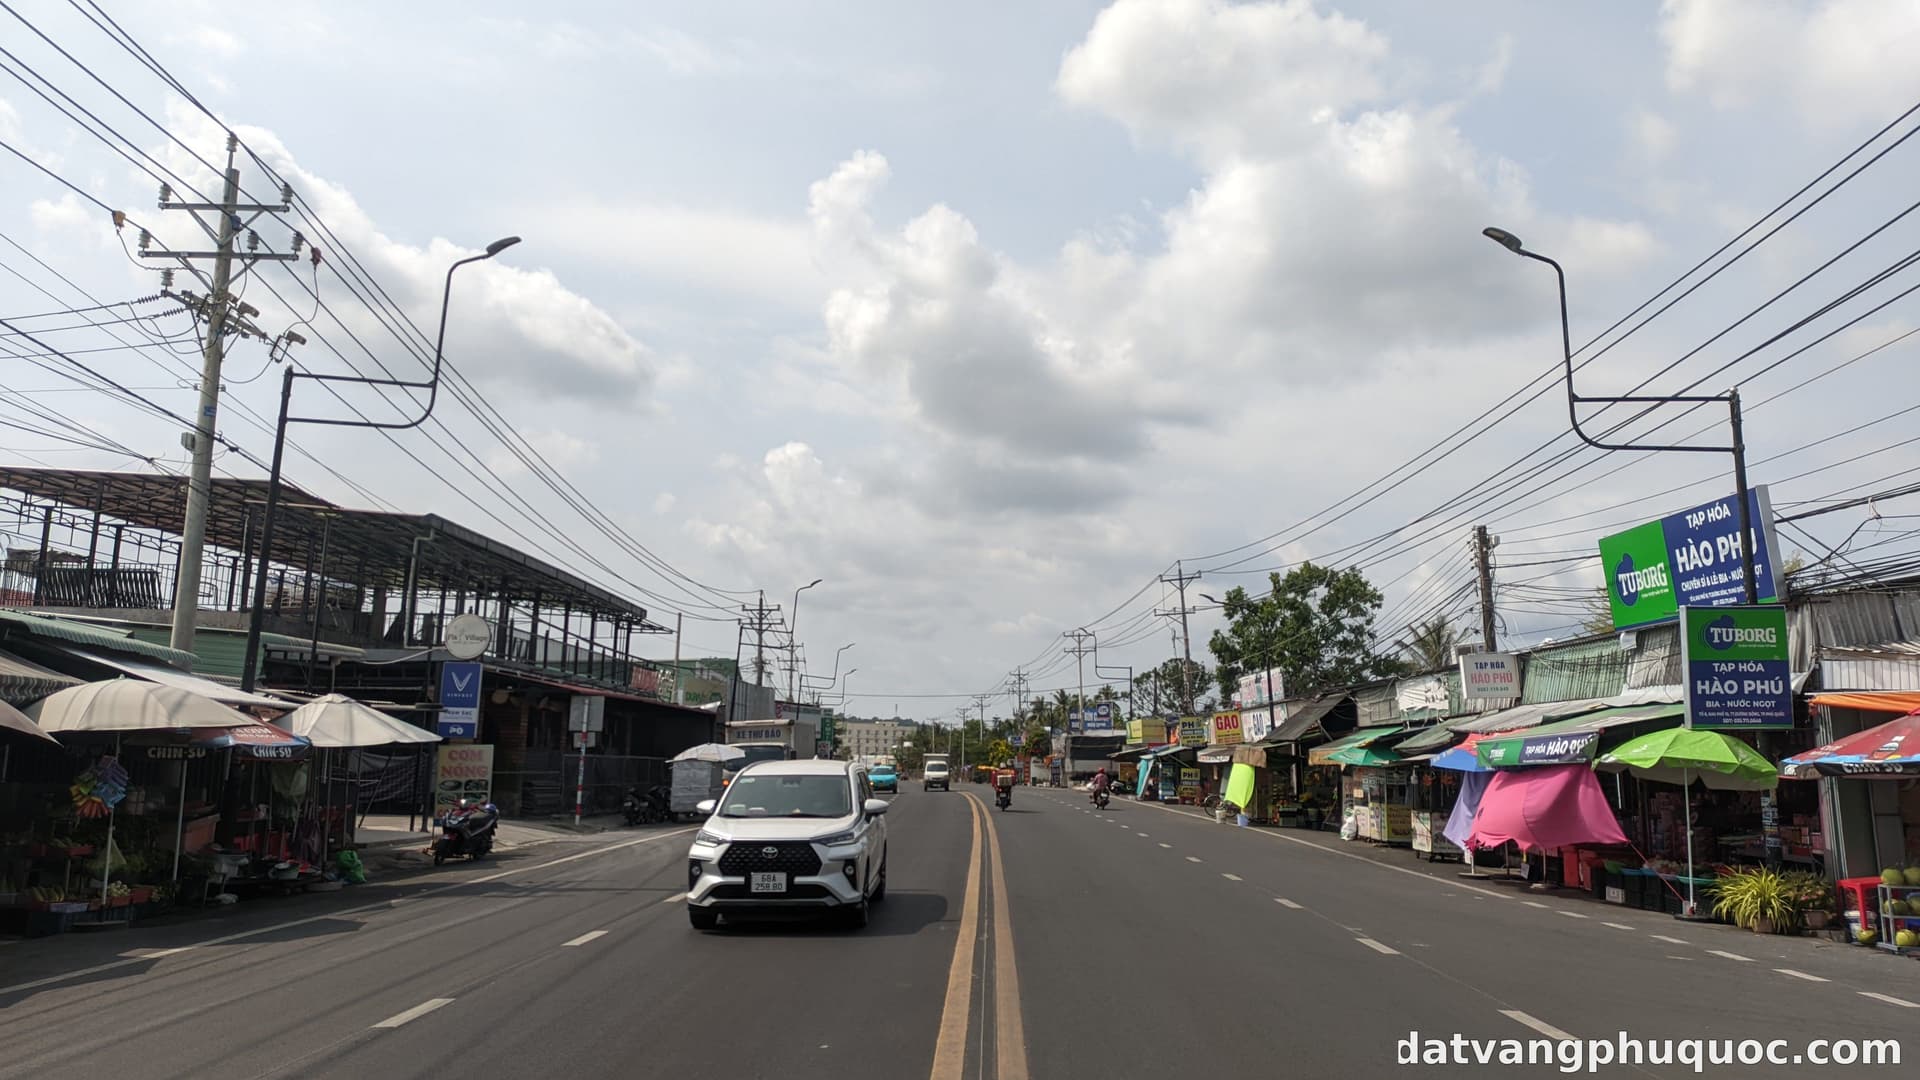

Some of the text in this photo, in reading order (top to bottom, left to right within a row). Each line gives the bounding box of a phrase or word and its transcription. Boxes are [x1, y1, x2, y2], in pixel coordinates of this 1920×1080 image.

[1686, 502, 1731, 530] TẠP HÓA
[1675, 538, 1714, 574] HÀO
[1618, 562, 1668, 596] TUBORG
[1710, 627, 1776, 643] TUBORG
[1712, 660, 1765, 675] TẠP HÓA
[1696, 676, 1784, 695] HÀO PHÚ
[1727, 699, 1751, 708] NƯỚC
[1753, 701, 1776, 710] NGỌT
[147, 746, 206, 758] CHIN-SU
[252, 746, 292, 758] CHIN-SU
[1546, 737, 1569, 756] HÀO
[761, 874, 776, 882] 68A
